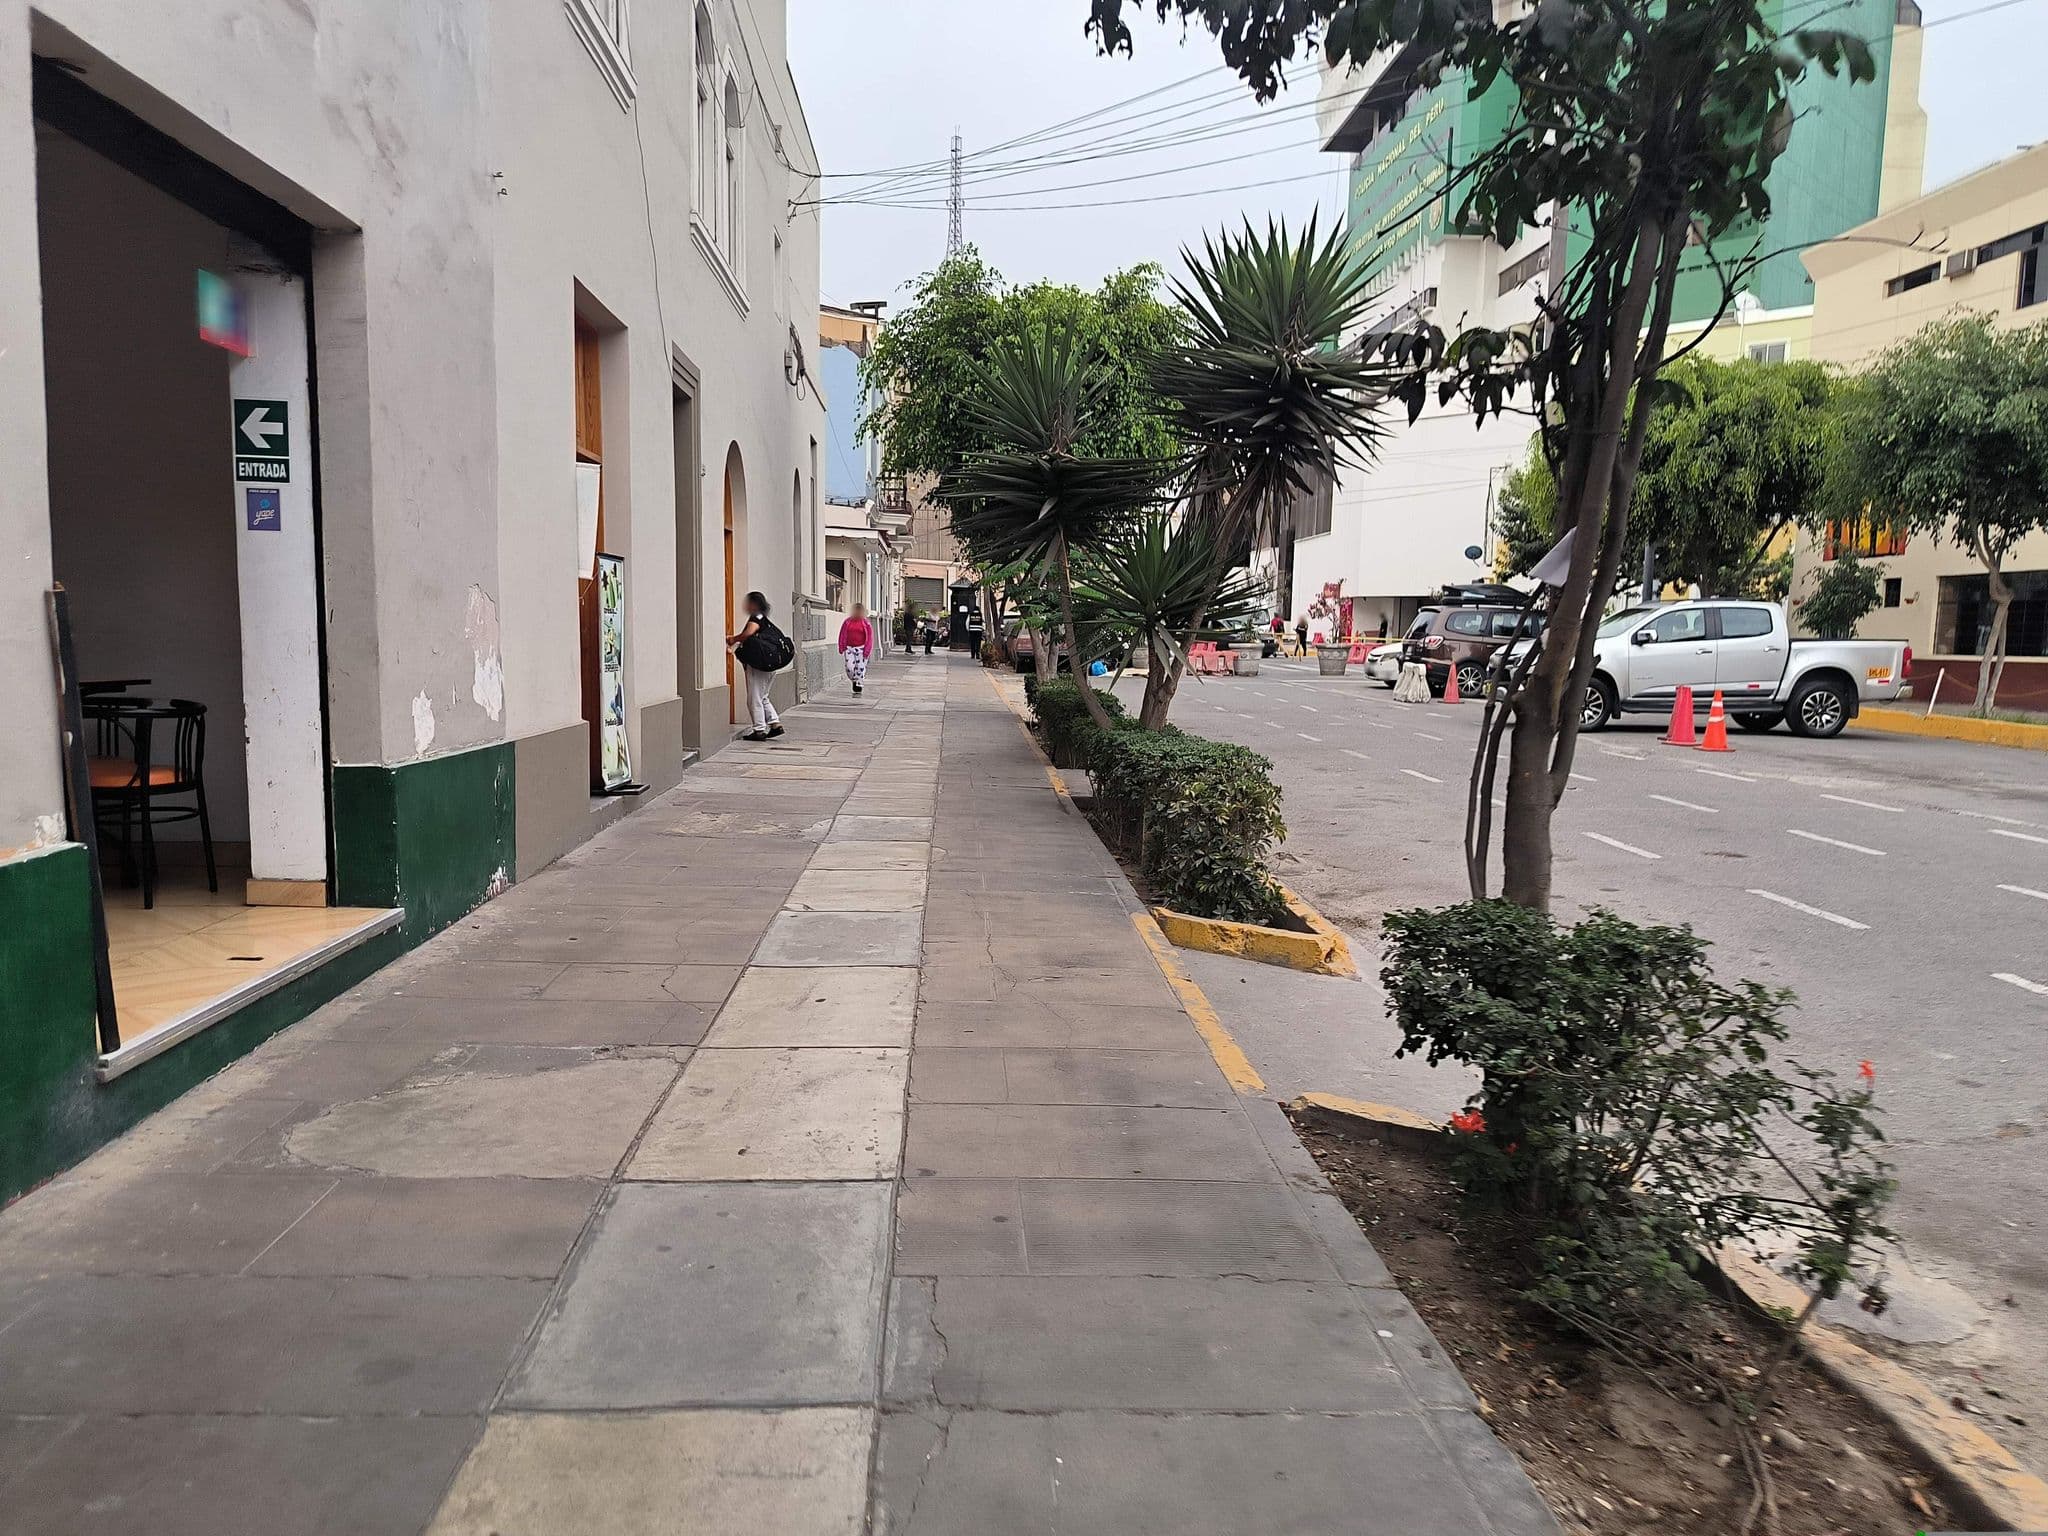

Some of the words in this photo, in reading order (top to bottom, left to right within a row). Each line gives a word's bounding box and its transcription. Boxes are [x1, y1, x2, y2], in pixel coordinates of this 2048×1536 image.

[1377, 139, 1406, 175] NACIONAL
[1409, 121, 1421, 144] DEL
[238, 462, 287, 478] ENTRADA
